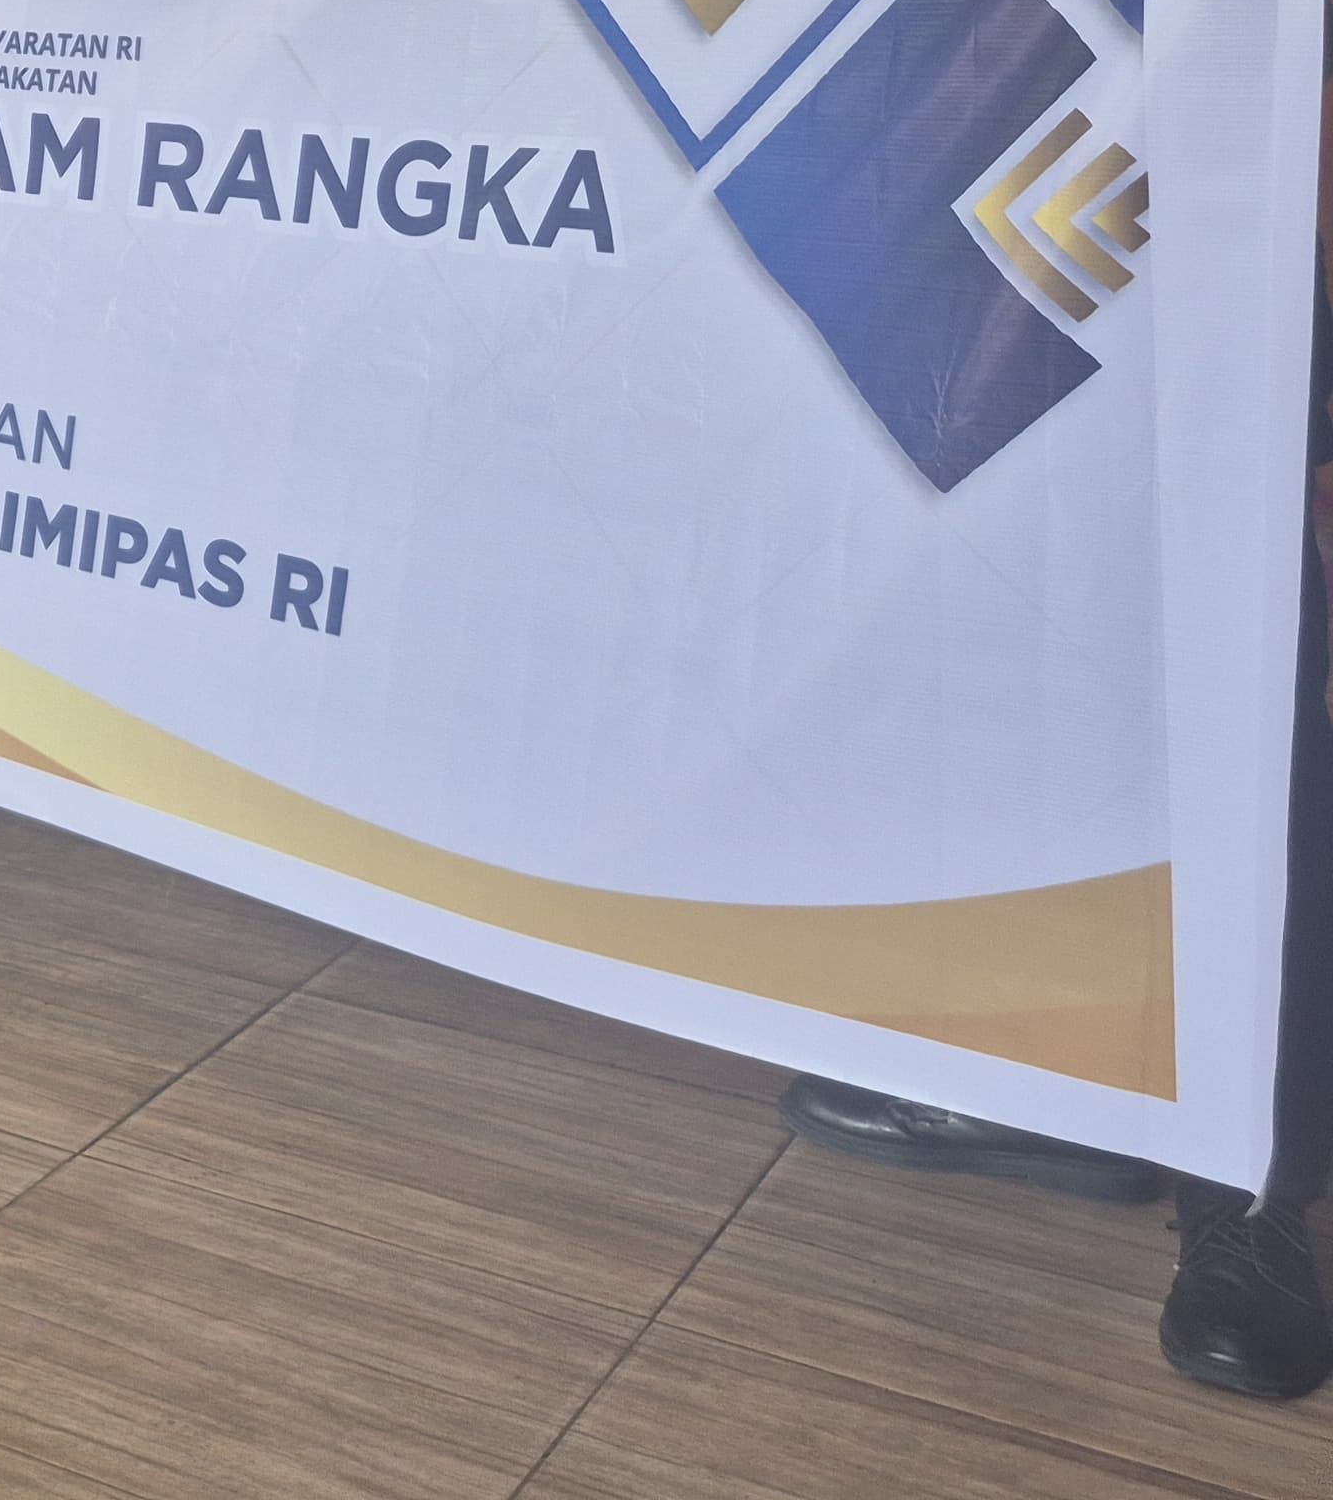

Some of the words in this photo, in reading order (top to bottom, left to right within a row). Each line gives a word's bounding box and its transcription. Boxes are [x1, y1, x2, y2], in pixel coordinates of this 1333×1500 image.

[116, 35, 142, 61] RI
[136, 121, 616, 255] RANGKA
[269, 552, 349, 637] RI
